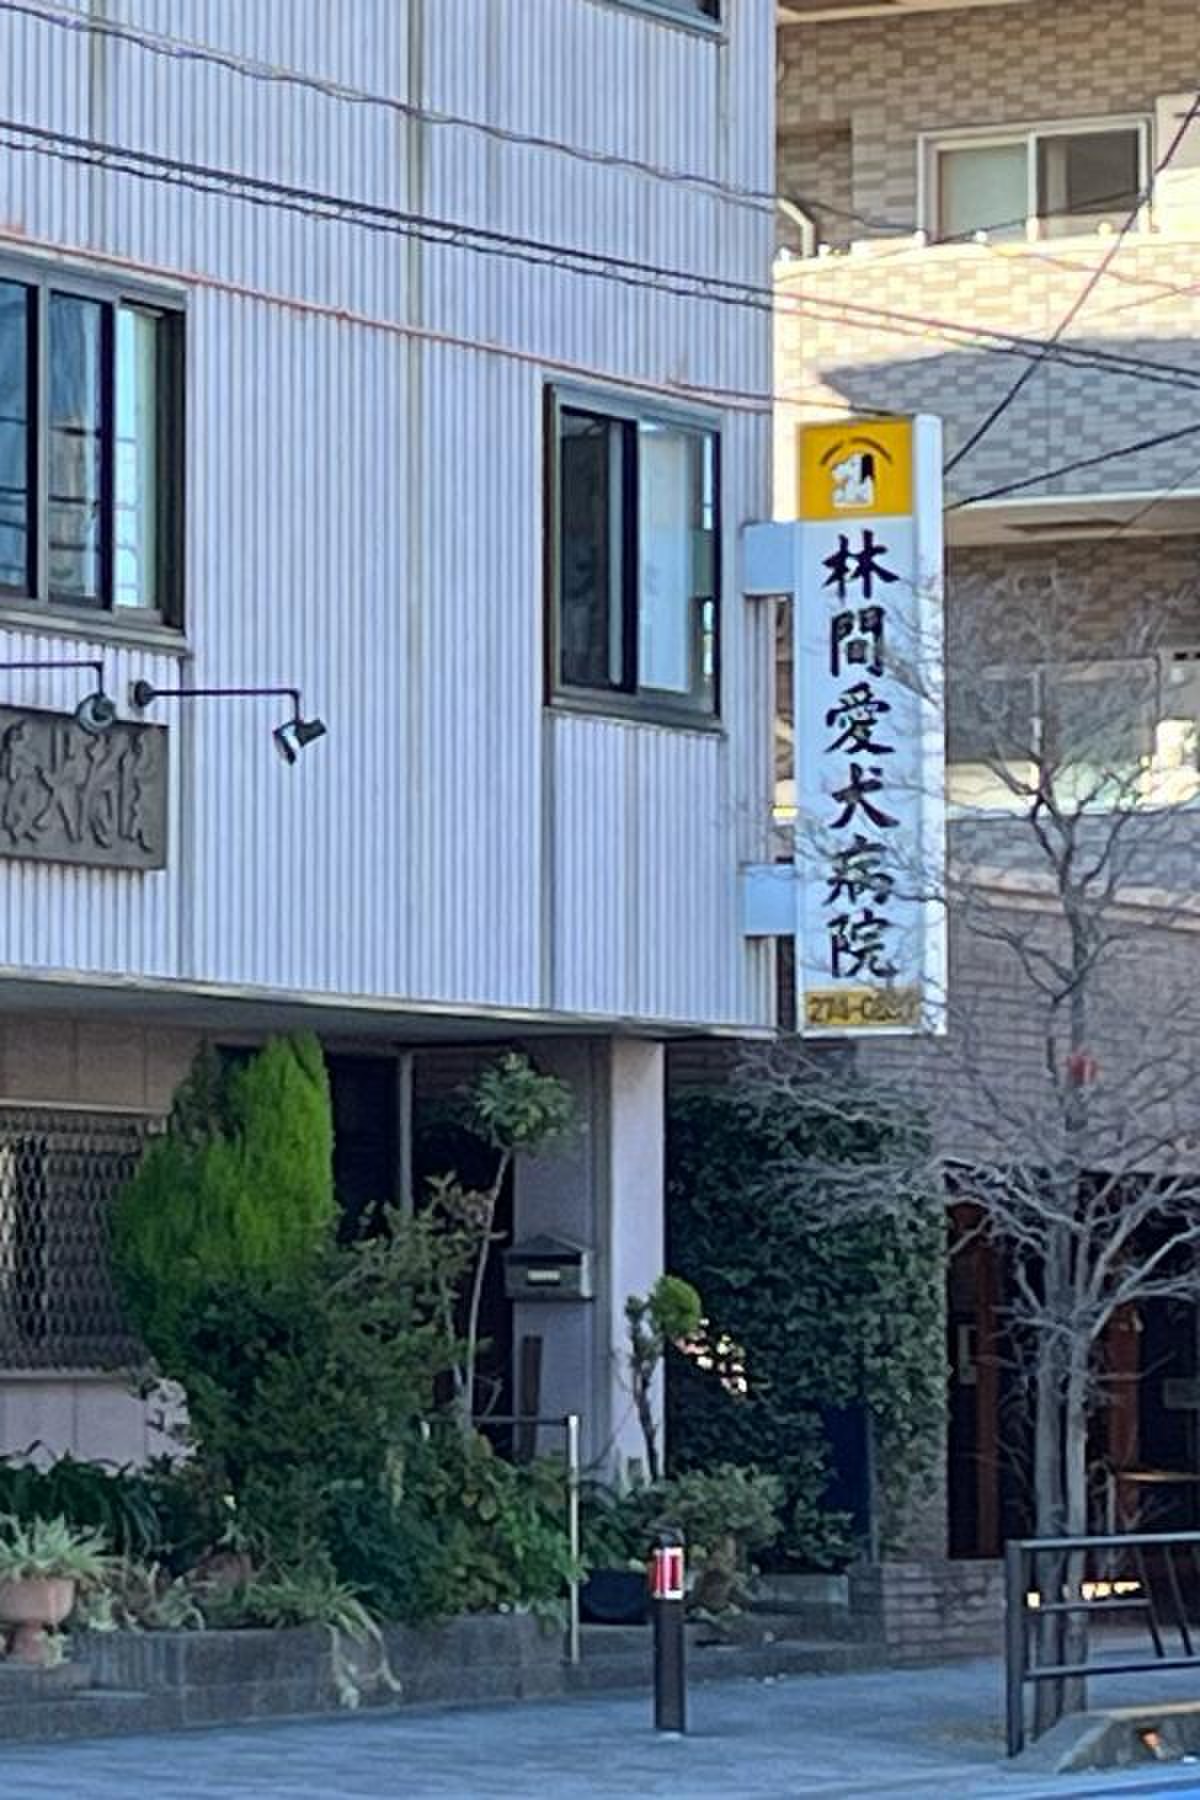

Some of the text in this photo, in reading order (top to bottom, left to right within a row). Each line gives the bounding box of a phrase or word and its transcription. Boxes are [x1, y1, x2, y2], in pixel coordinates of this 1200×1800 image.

[821, 529, 901, 978] 林間愛犬病院
